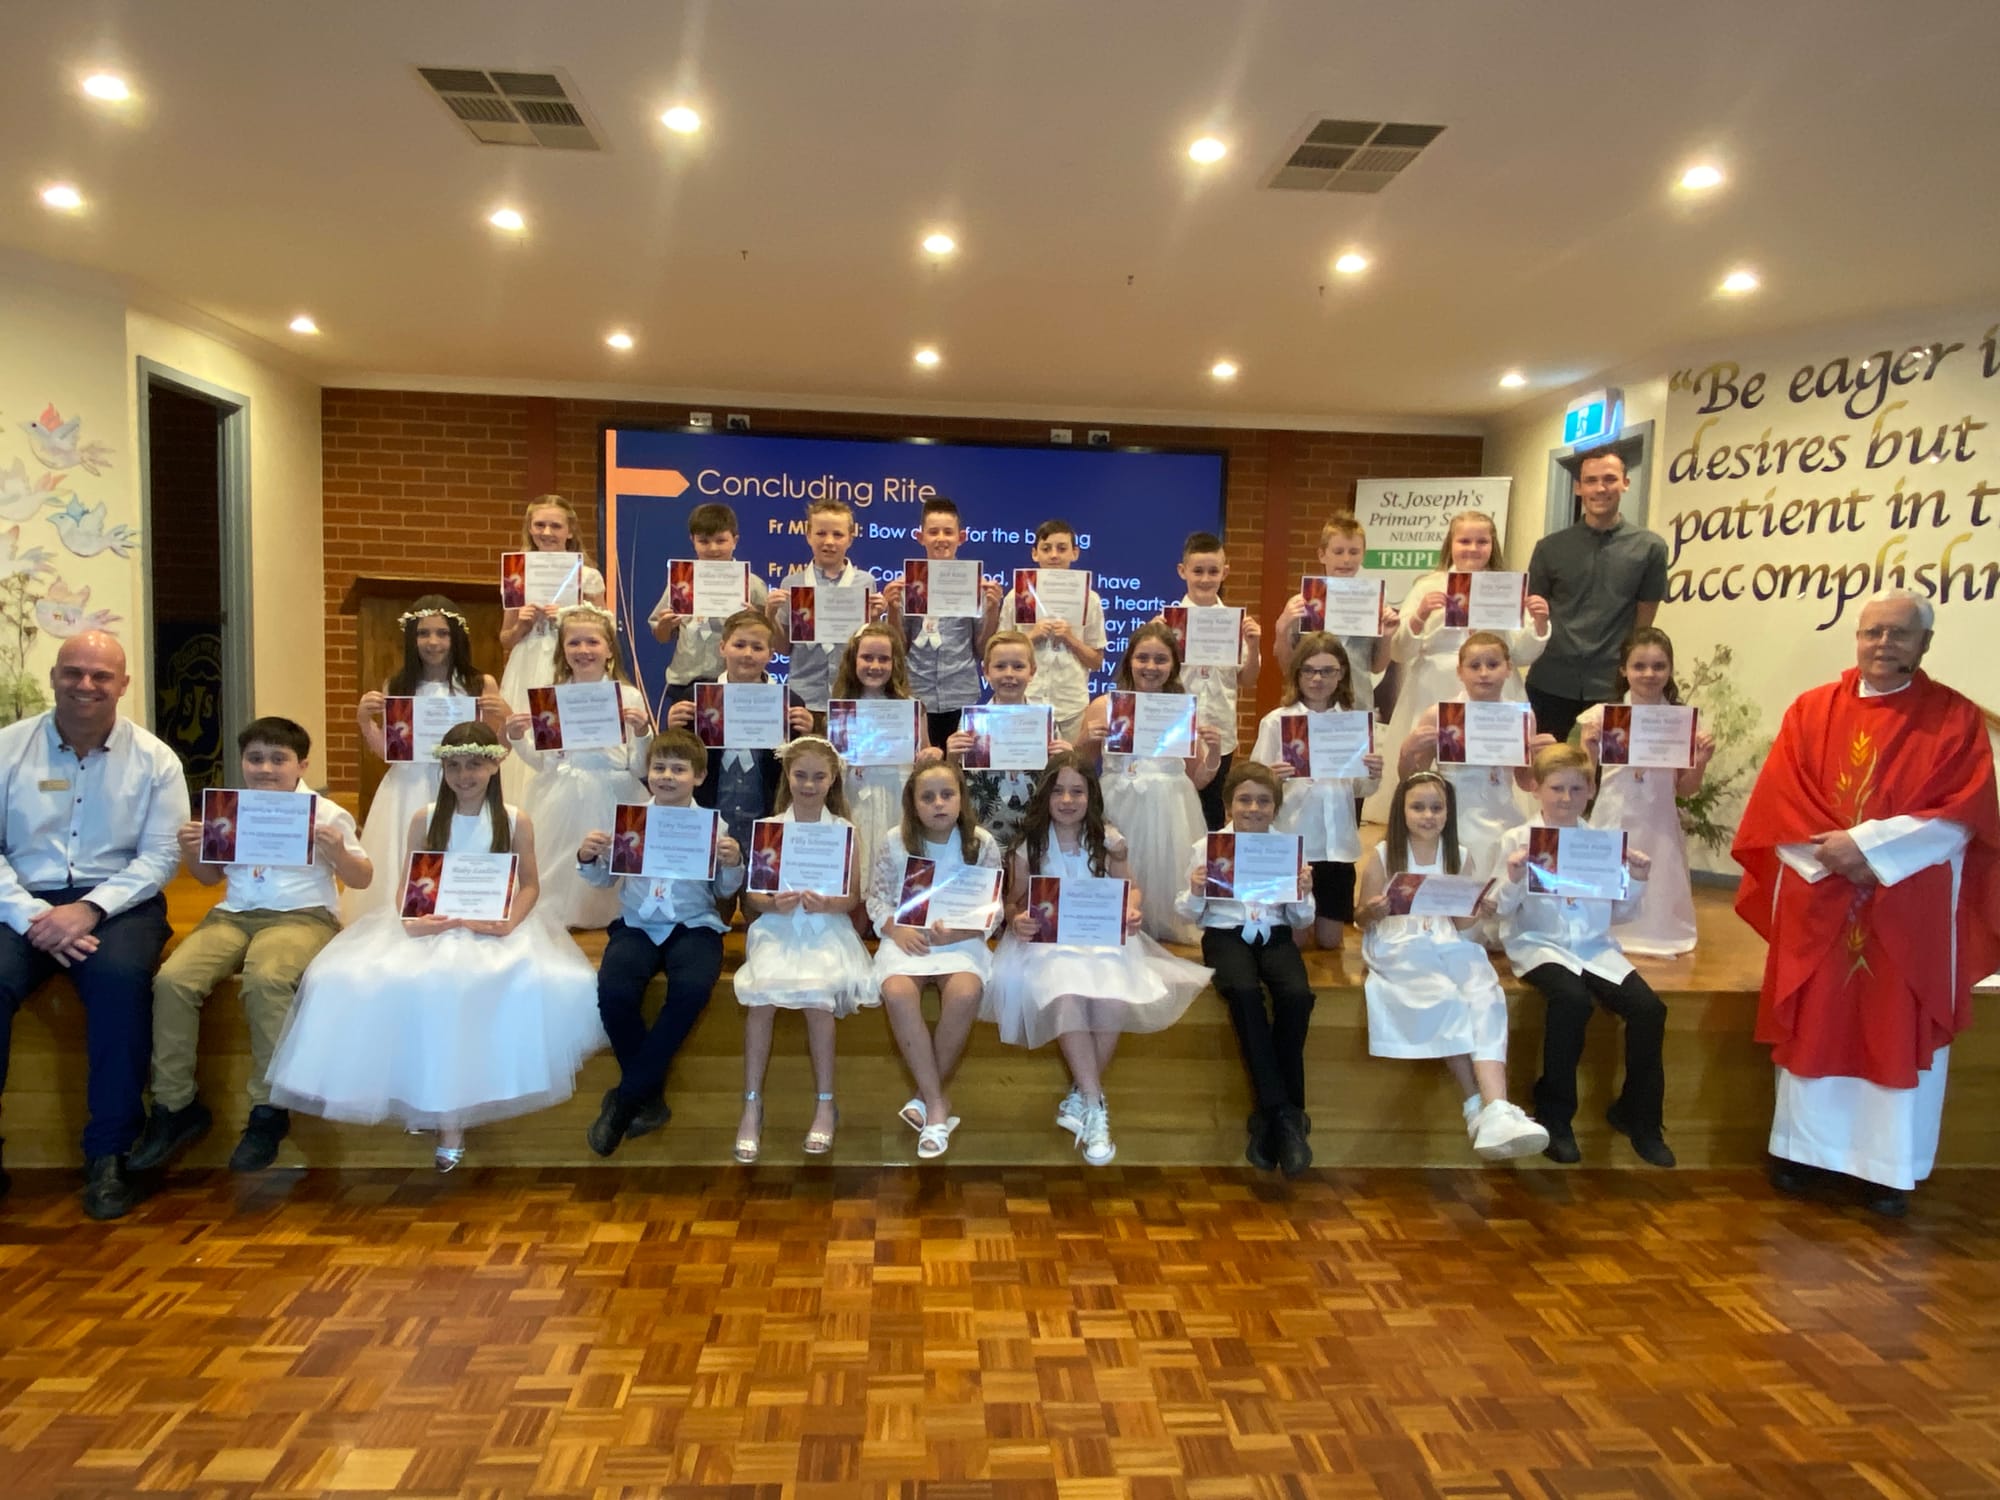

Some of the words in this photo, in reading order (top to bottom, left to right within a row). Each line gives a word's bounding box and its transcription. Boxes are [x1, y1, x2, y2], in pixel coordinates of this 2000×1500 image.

[1788, 342, 1965, 420] eager
[1668, 416, 1852, 484] desires
[1865, 400, 1988, 469] but
[697, 469, 873, 508] Concluding
[884, 478, 937, 503] Rite
[768, 519, 784, 534] Fr
[869, 523, 906, 539] Bow
[965, 526, 988, 542] for
[997, 527, 1020, 544] the
[1369, 512, 1436, 529] Primary
[1666, 486, 1875, 569] patient
[1886, 476, 1951, 529] in
[1389, 531, 1445, 543] NUMURK
[768, 562, 783, 577] Fr
[1097, 573, 1141, 590] have
[1115, 595, 1166, 612] hearts
